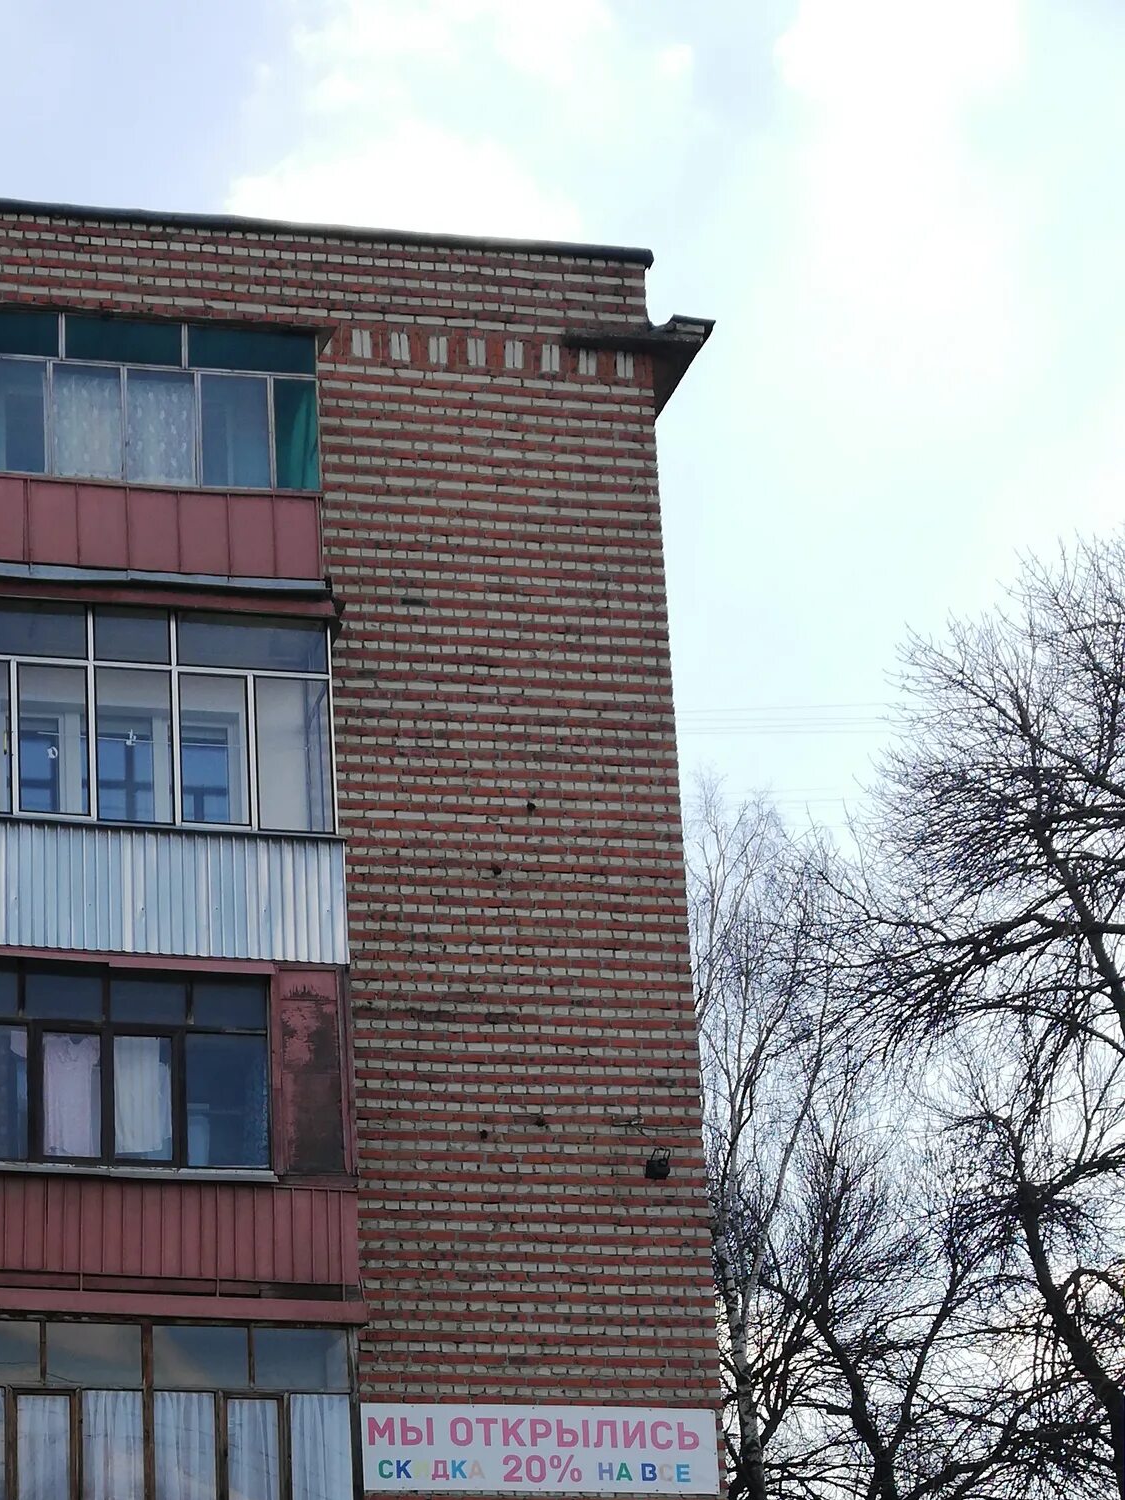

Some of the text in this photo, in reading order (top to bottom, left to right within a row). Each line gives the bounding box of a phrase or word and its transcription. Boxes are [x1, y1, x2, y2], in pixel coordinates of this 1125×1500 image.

[366, 1416, 700, 1451] МЫ ОТКРЫЛИСЬ
[502, 1454, 583, 1484] 20%
